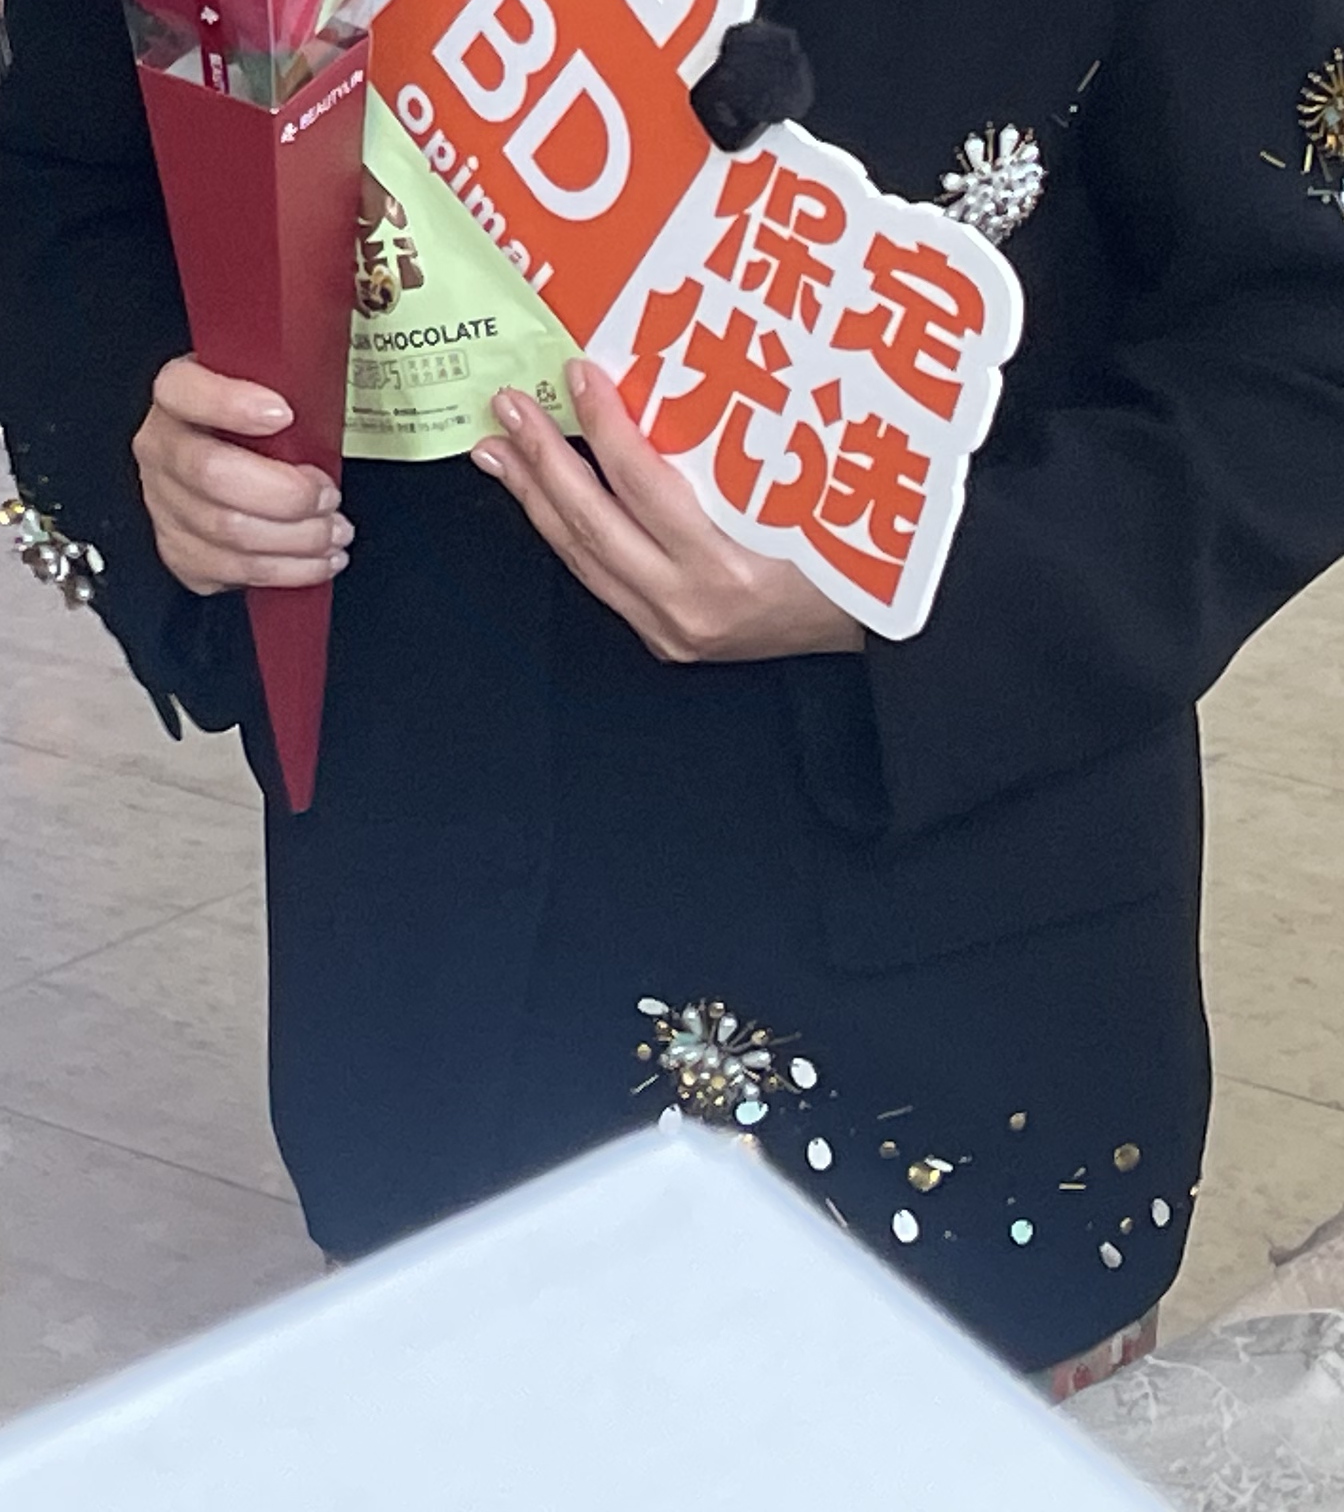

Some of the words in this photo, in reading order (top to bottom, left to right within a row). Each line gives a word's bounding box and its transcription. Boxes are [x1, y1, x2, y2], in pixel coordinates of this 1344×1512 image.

[373, 316, 499, 353] CHOCOLATE
[703, 149, 985, 422] 保定
[616, 276, 931, 607] 优选
